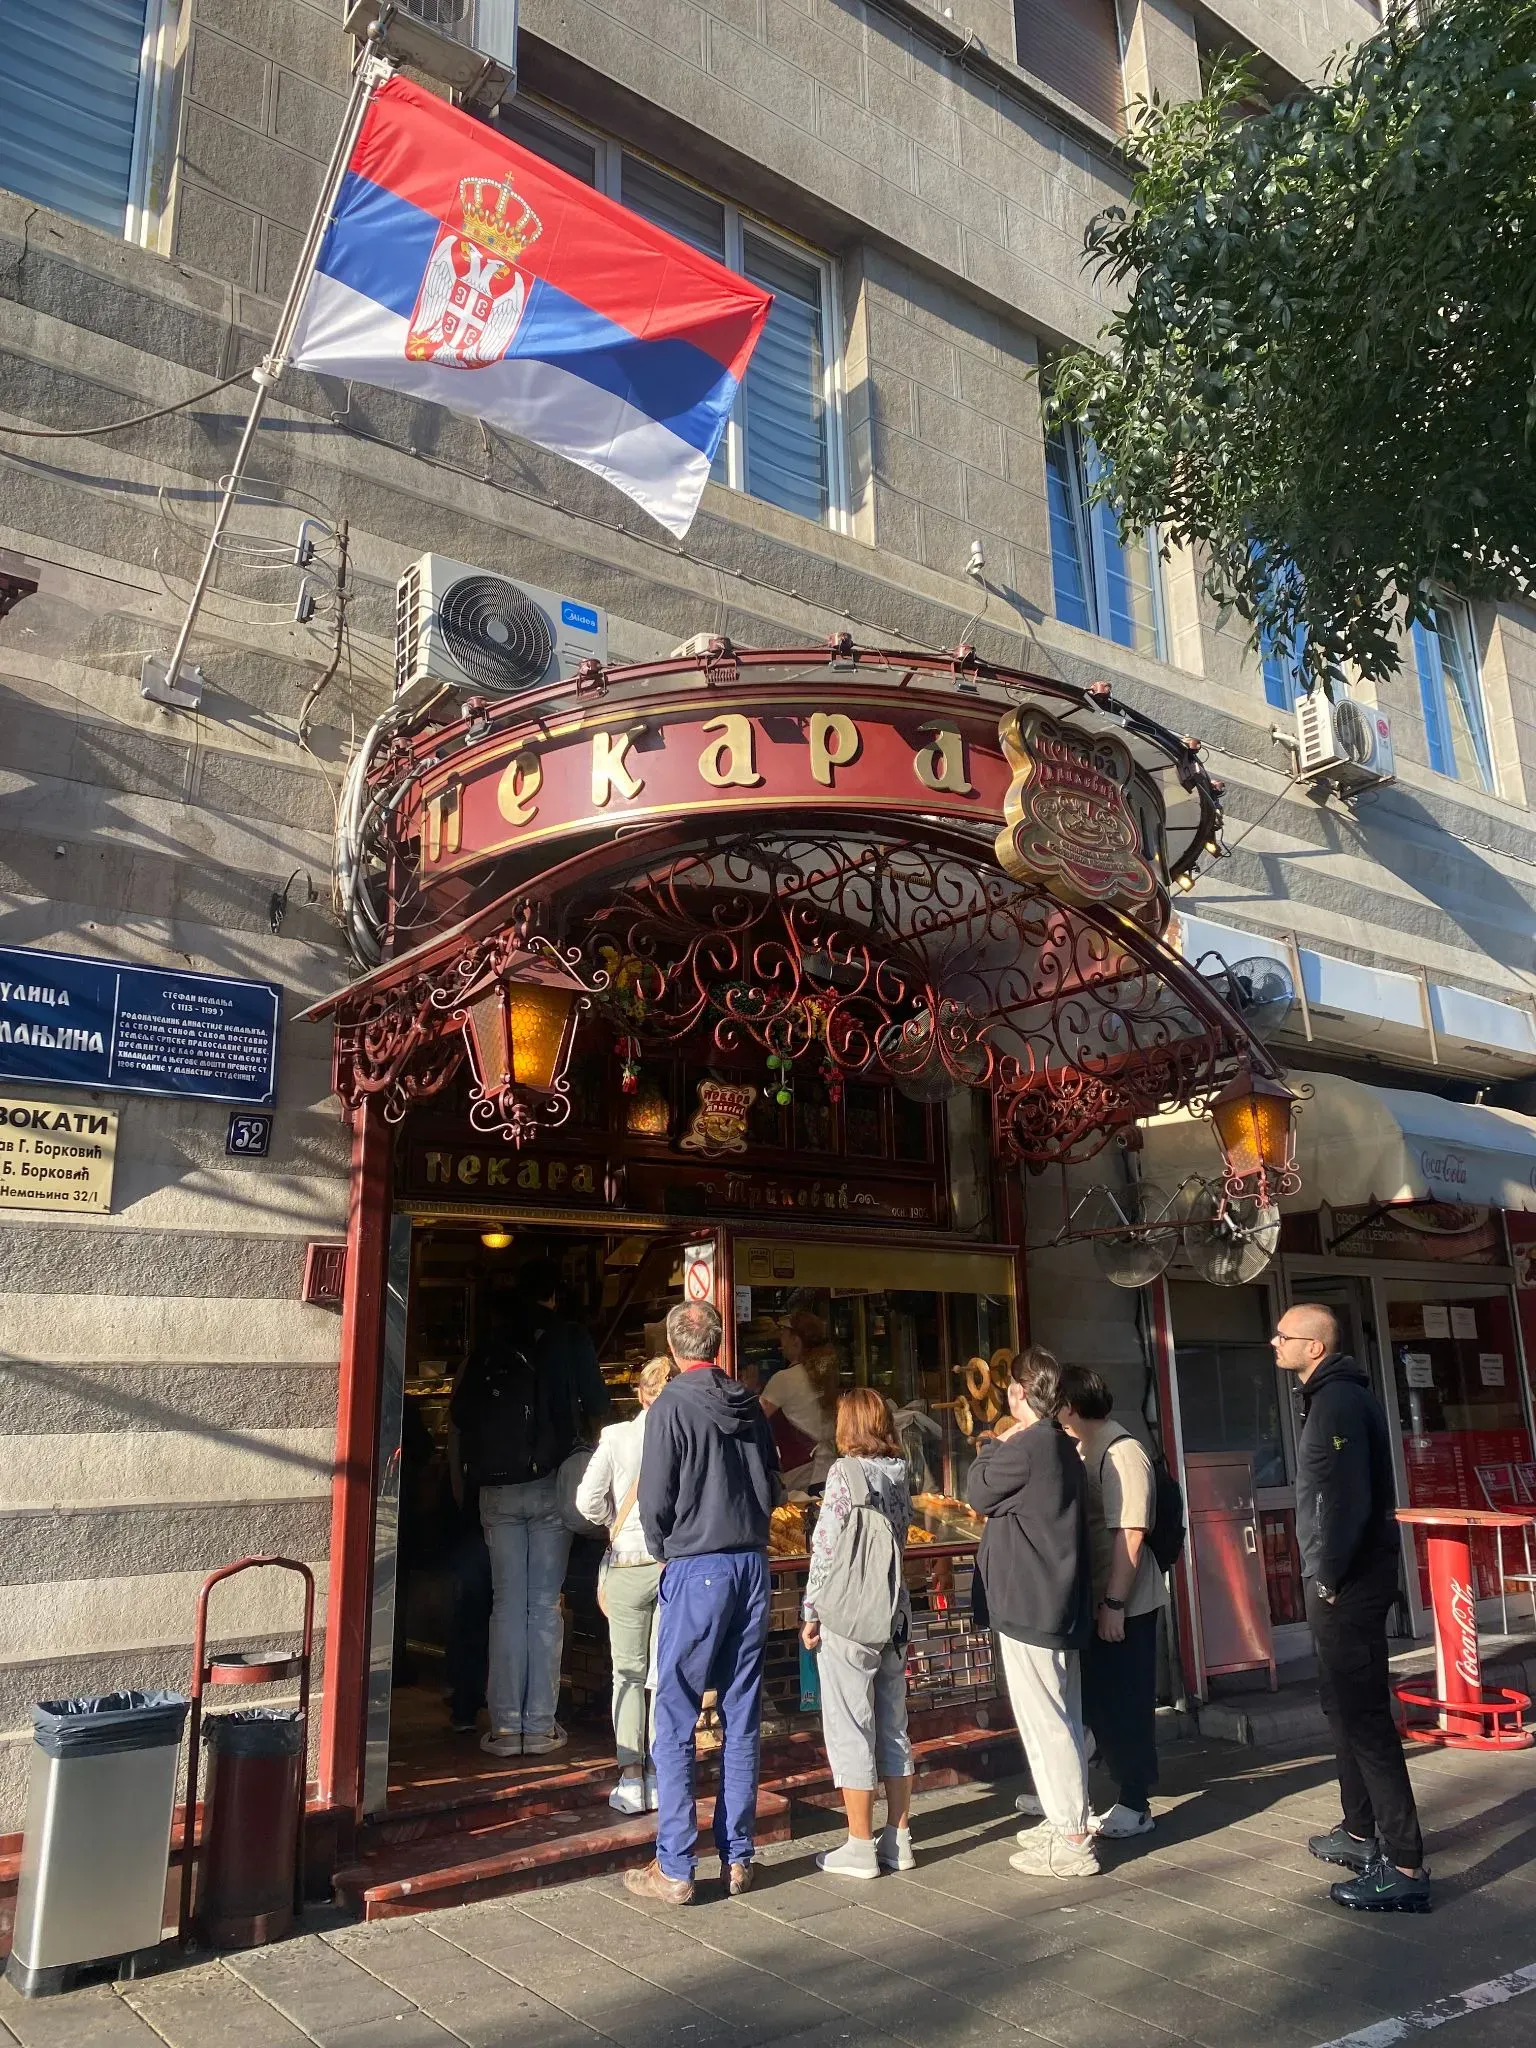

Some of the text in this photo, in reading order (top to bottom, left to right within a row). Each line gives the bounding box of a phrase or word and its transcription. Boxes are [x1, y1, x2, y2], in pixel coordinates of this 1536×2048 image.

[564, 608, 596, 627] Midea
[0, 982, 70, 1007] УЛИЦА
[163, 991, 233, 1007] СТЕФАН НЕМАЊА
[133, 1023, 165, 1032] СВОЈИМ
[168, 1027, 196, 1036] СИНОМ
[198, 1031, 226, 1040] САВОМ
[228, 1035, 268, 1045] ПОСТАВИО
[182, 1020, 223, 1031] ДИНАСТИЈЕ
[119, 1040, 165, 1052] ПРЕМИНУО
[179, 1047, 194, 1055] КАО
[197, 1050, 225, 1060] МОНАХ
[228, 1053, 261, 1062] СИМЕОН
[120, 1031, 269, 1055] ТЕМЕЉЕ СРПСКЕ ПРАВОСЛАВНЕ ЦРКВЕ.
[118, 1050, 160, 1062] ХИЛАНДАРУ
[169, 1057, 198, 1066] ЊЕГОВЕ
[200, 1060, 226, 1069] МОШТИ
[228, 1063, 257, 1072] ПРЕНЕТЕ
[136, 1063, 166, 1072] ГОДИНЕ
[174, 1067, 213, 1077] МАНАСТИР
[235, 1121, 263, 1148] 32
[19, 1139, 29, 1153] Г.
[35, 1140, 102, 1159] Борковић
[3, 1161, 90, 1181] Б. Борковић
[1421, 1150, 1467, 1184] Coca-Cola
[0, 1185, 69, 1200] Немањина
[1450, 1576, 1481, 1688] Coca-Cola
